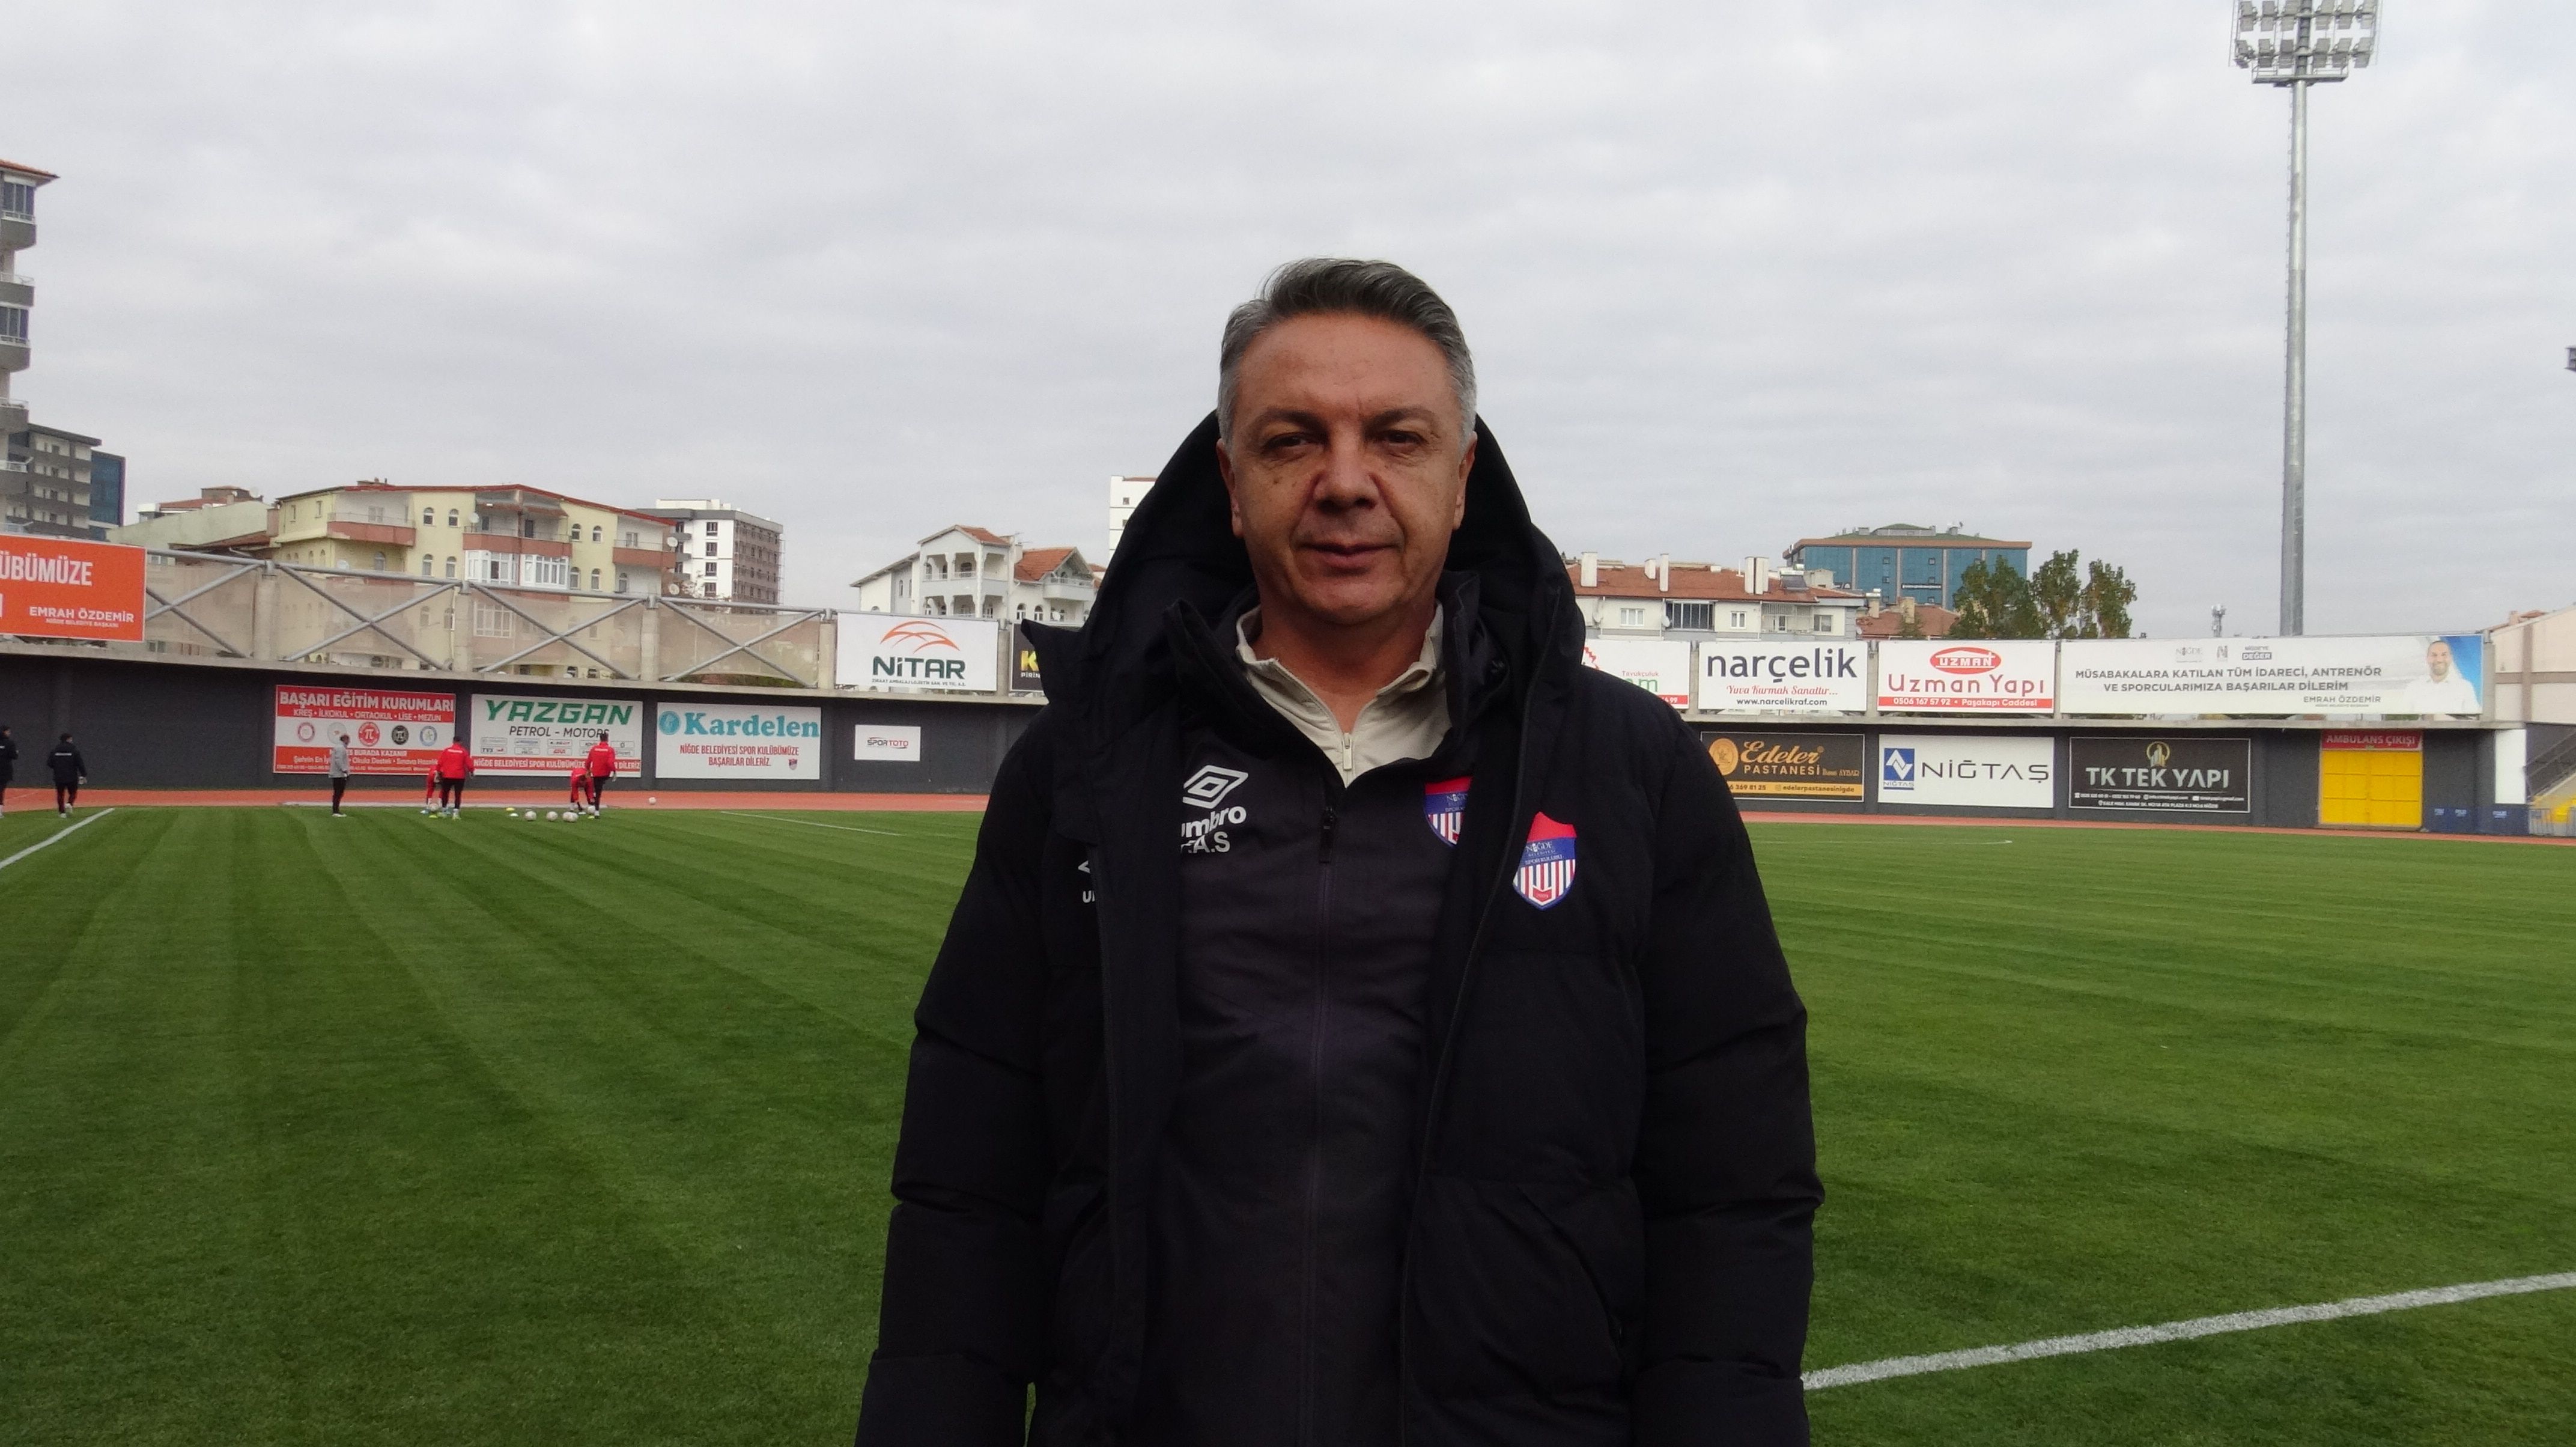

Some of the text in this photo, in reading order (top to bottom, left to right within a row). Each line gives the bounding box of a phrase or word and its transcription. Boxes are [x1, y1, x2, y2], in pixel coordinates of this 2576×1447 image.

[29, 606, 135, 623] EMRAH ÖZDEMİR
[1707, 647, 1858, 683] narçelik
[1939, 656, 1993, 666] UZMAN
[2076, 665, 2381, 678] MÜSABAKALARA KATILAN TÜM İDARECİ, ANTRENÖR
[1727, 685, 1749, 695] Yuva
[1751, 685, 1788, 695] Kurmak
[1888, 674, 2044, 697] Uzman Yapı
[2104, 680, 2348, 692] VE SPORCULARIMIZA BAŞARILAR DİLERİM
[279, 691, 454, 711] BAŞARI EĞİTİM KURUMLARI
[1736, 698, 1827, 706] www.narcelikraf.com
[1961, 698, 2000, 707] Paşakapı
[293, 708, 442, 722] KREŞ İLKOKUL ORTAOKUL LİSE MEZUN
[485, 699, 634, 725] YAZGAN
[509, 725, 551, 737] PETROL
[684, 712, 820, 738] Kardelen
[2327, 735, 2415, 746] AMBULANS ÇIKIŞI
[679, 744, 800, 756] NİĞDE BELEDİYESİ SPOR KULÜBÜMÜZE
[1740, 740, 1821, 764] Edeler
[473, 758, 493, 767] NİĞDE
[494, 759, 528, 767] BELEDİYESİ
[619, 760, 641, 770] DİLERİZ
[708, 757, 744, 767] BAŞARILAR
[1743, 764, 1820, 775] PASTANESİ
[1922, 760, 2049, 784] NİĞTAŞ
[2085, 767, 2229, 788] TK TEK YAPI
